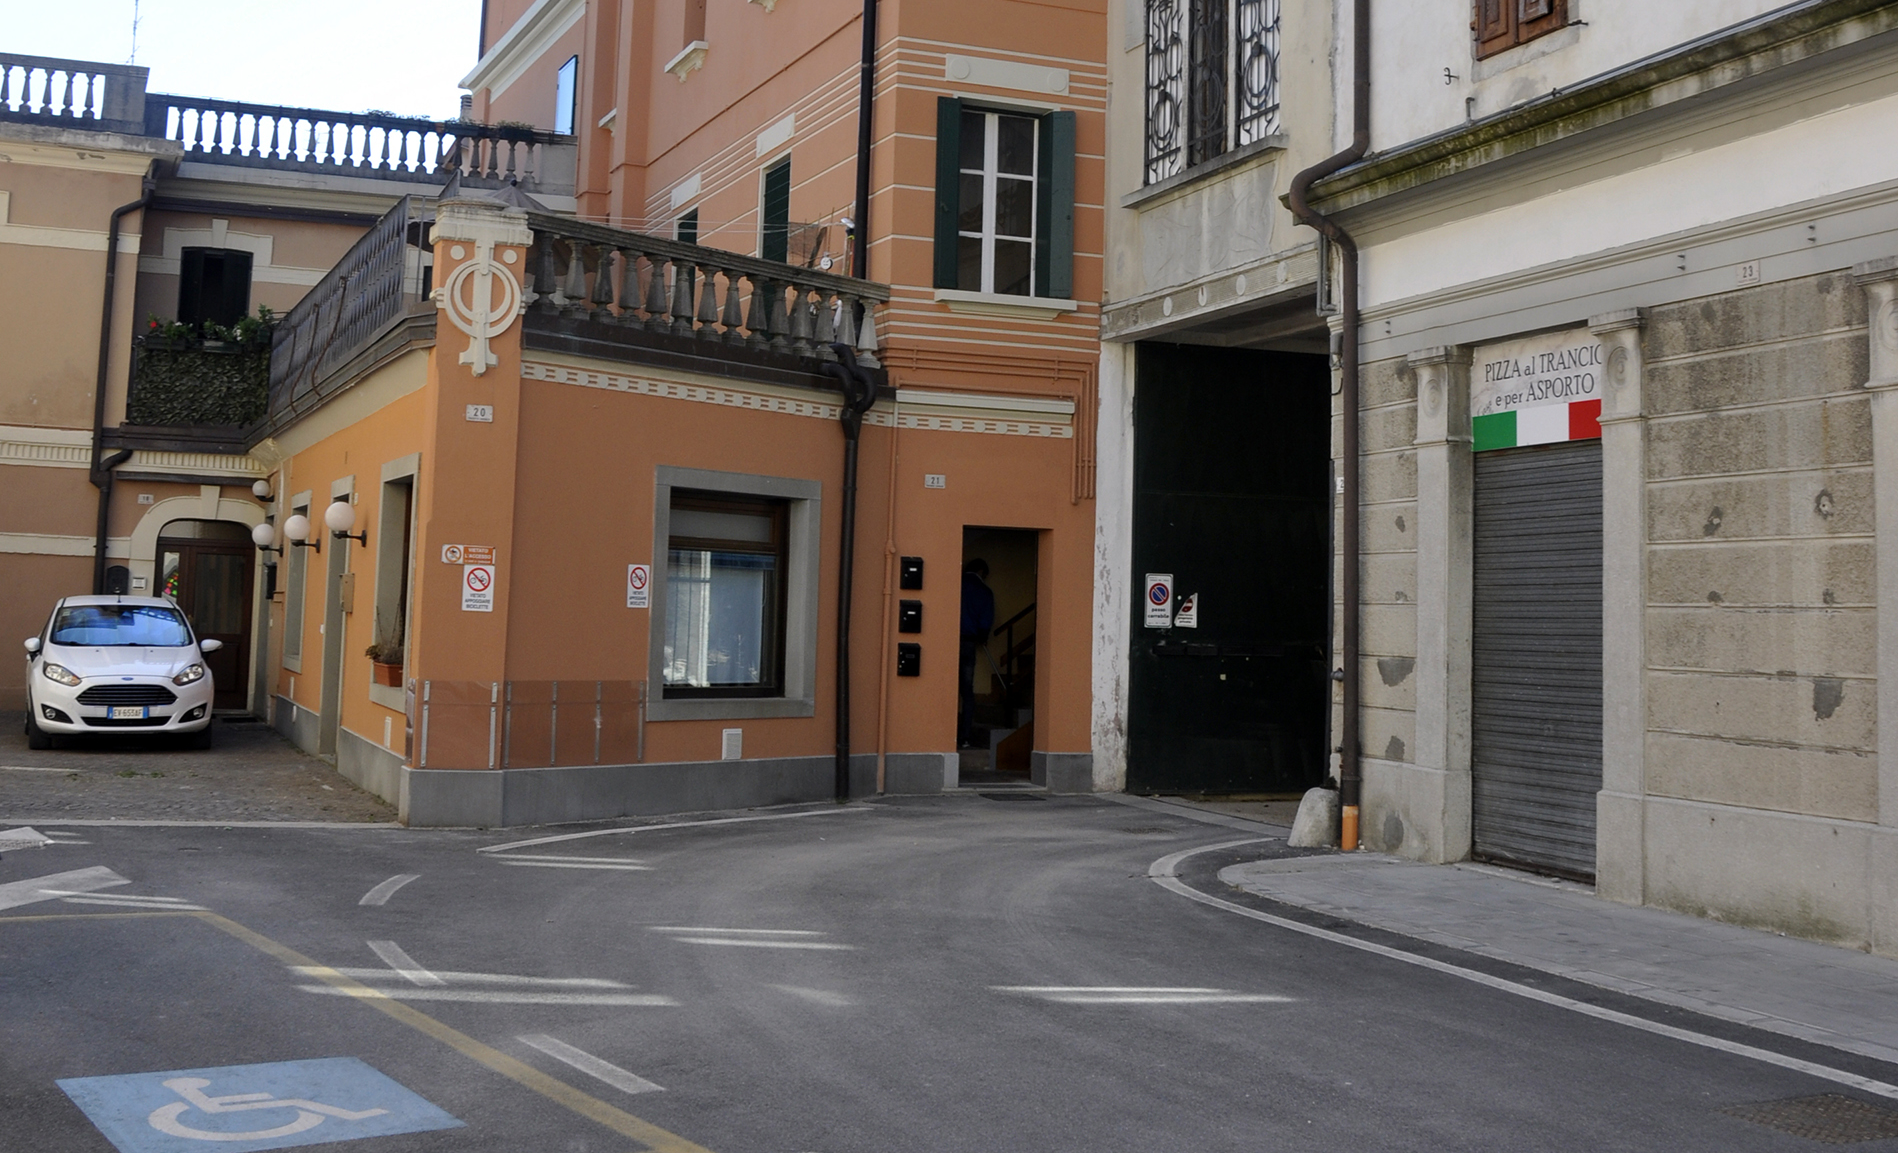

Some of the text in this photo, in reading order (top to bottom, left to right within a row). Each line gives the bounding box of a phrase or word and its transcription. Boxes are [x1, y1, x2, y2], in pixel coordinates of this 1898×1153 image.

[1743, 265, 1754, 278] 23
[1485, 358, 1521, 383] PIZZA
[1524, 356, 1535, 377] al
[1495, 395, 1502, 407] e
[1504, 392, 1523, 409] per
[1526, 373, 1595, 402] ASPORTO
[473, 407, 486, 417] 20
[931, 476, 940, 485] 21
